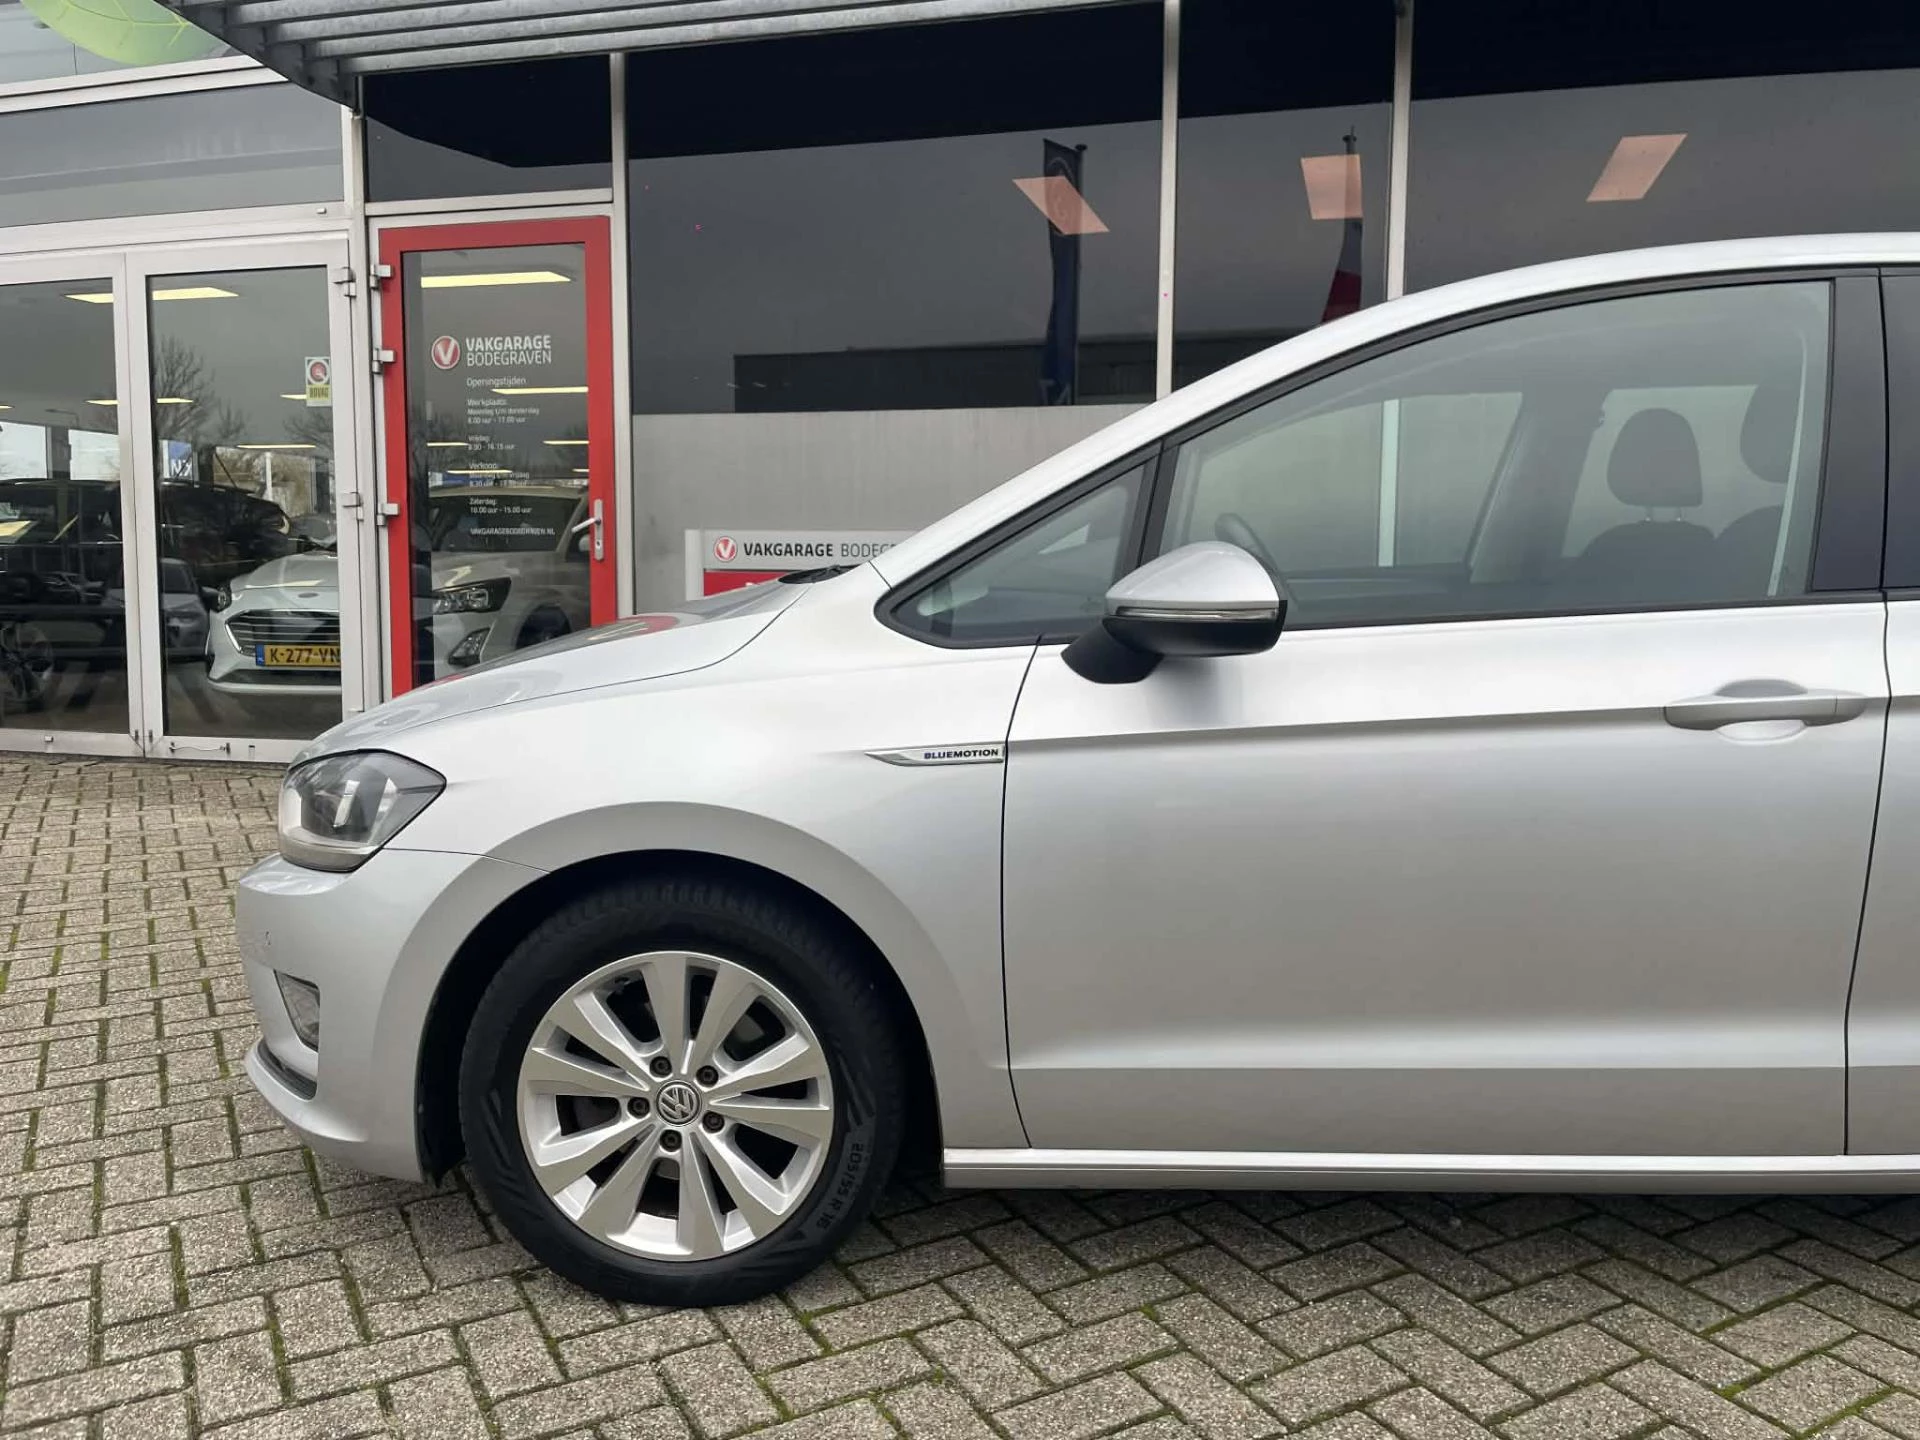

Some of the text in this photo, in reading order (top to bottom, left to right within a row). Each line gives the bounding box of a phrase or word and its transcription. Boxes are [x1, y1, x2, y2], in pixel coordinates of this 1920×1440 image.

[465, 335, 551, 351] VAKGARAGE
[466, 350, 552, 367] BODEGRAVEN
[466, 376, 527, 388] Openingstijden
[743, 543, 833, 557] VAKGARAGE
[840, 543, 897, 557] BODEG
[923, 748, 999, 760] BLUEMOTION
